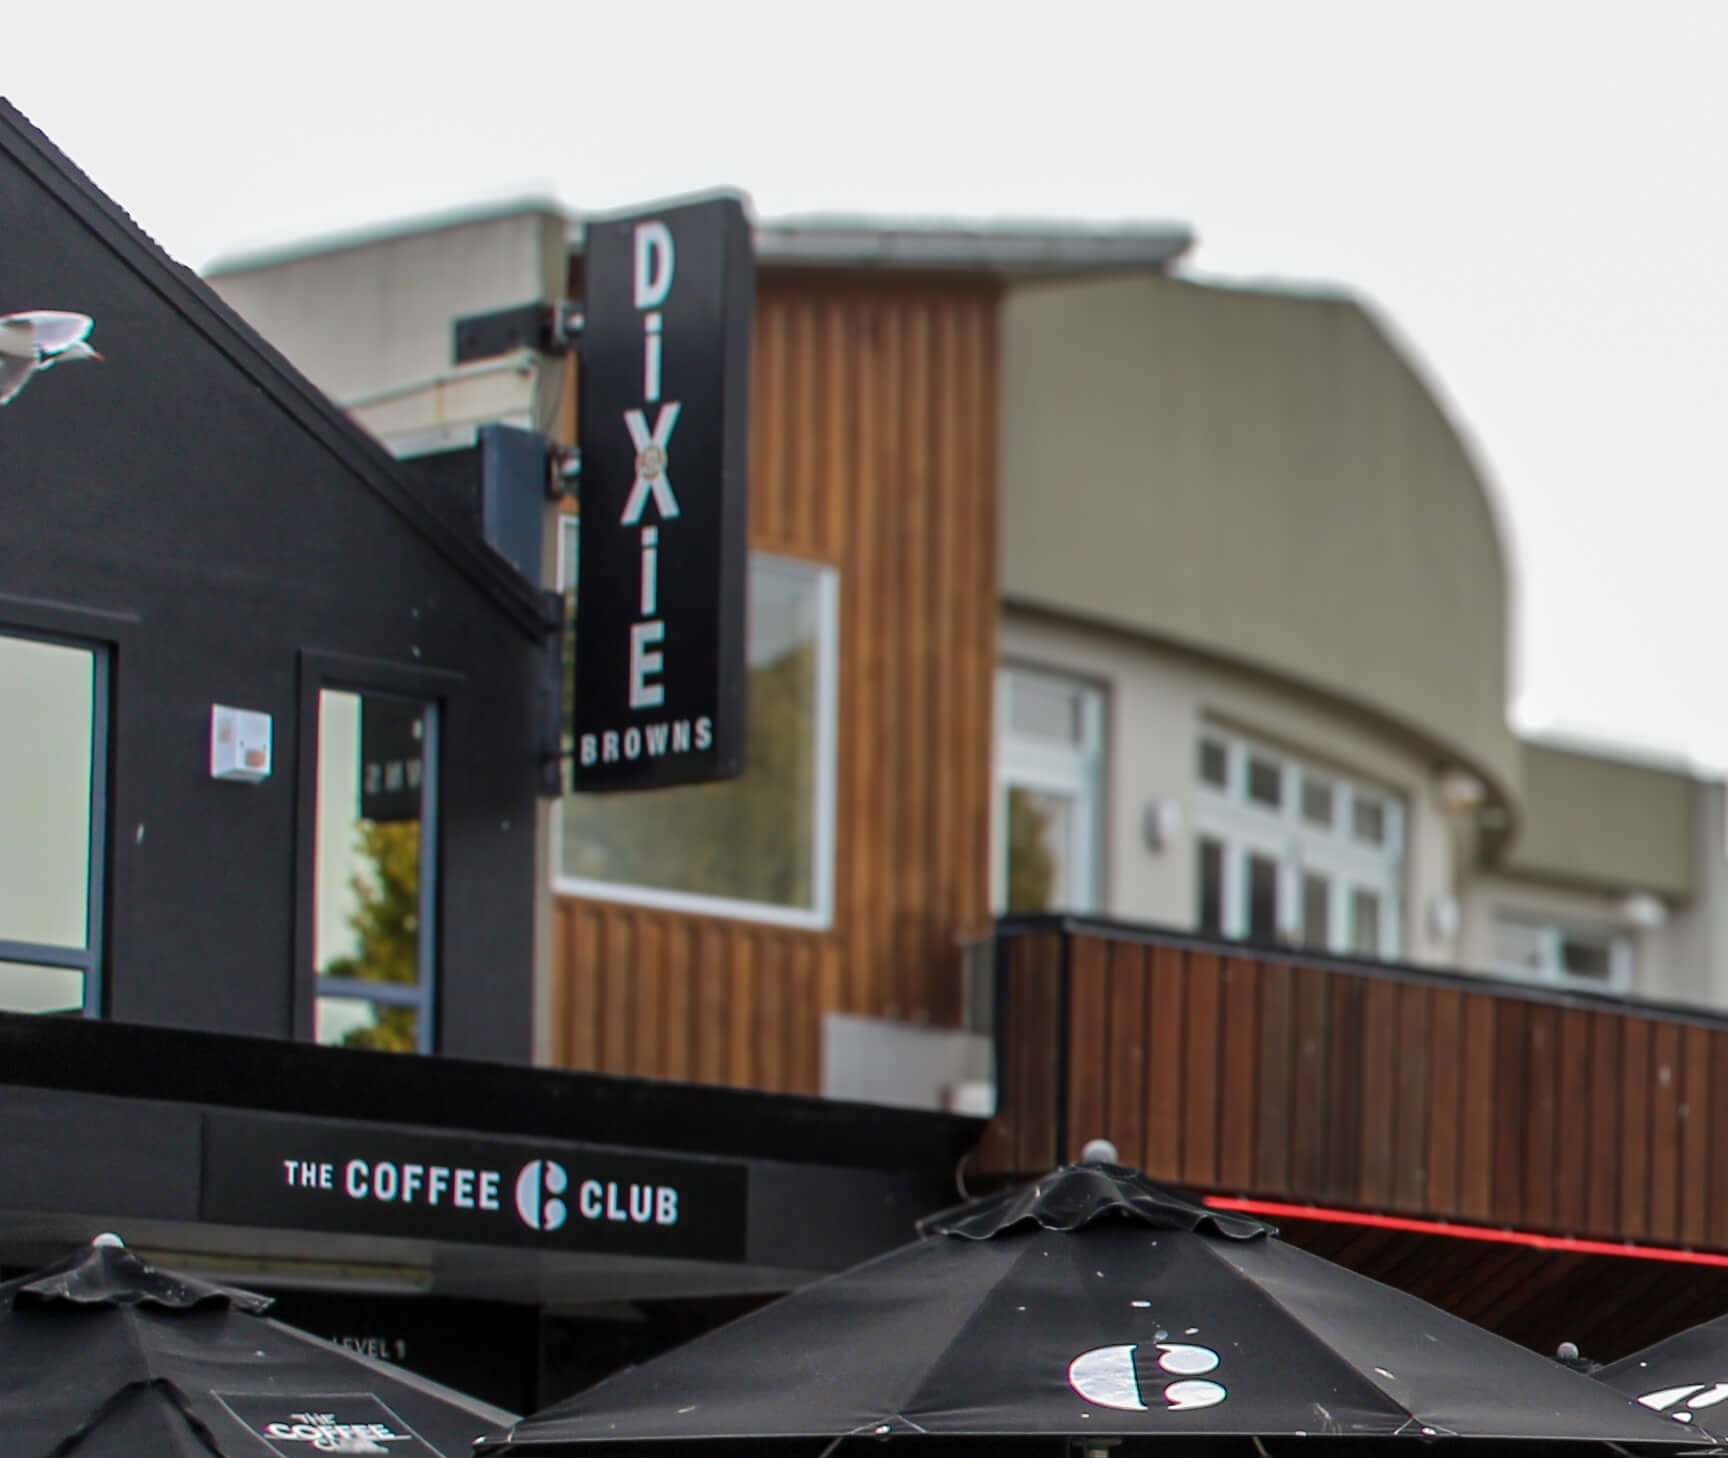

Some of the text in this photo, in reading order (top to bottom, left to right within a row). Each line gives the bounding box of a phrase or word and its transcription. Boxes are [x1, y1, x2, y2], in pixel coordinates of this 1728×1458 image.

[580, 716, 713, 767] BROWNS
[283, 1160, 334, 1189] THE
[344, 1158, 500, 1211] COFFEE
[579, 1179, 679, 1225] CLUB
[331, 1335, 392, 1359] EVEL
[264, 1423, 396, 1441] COFFEE
